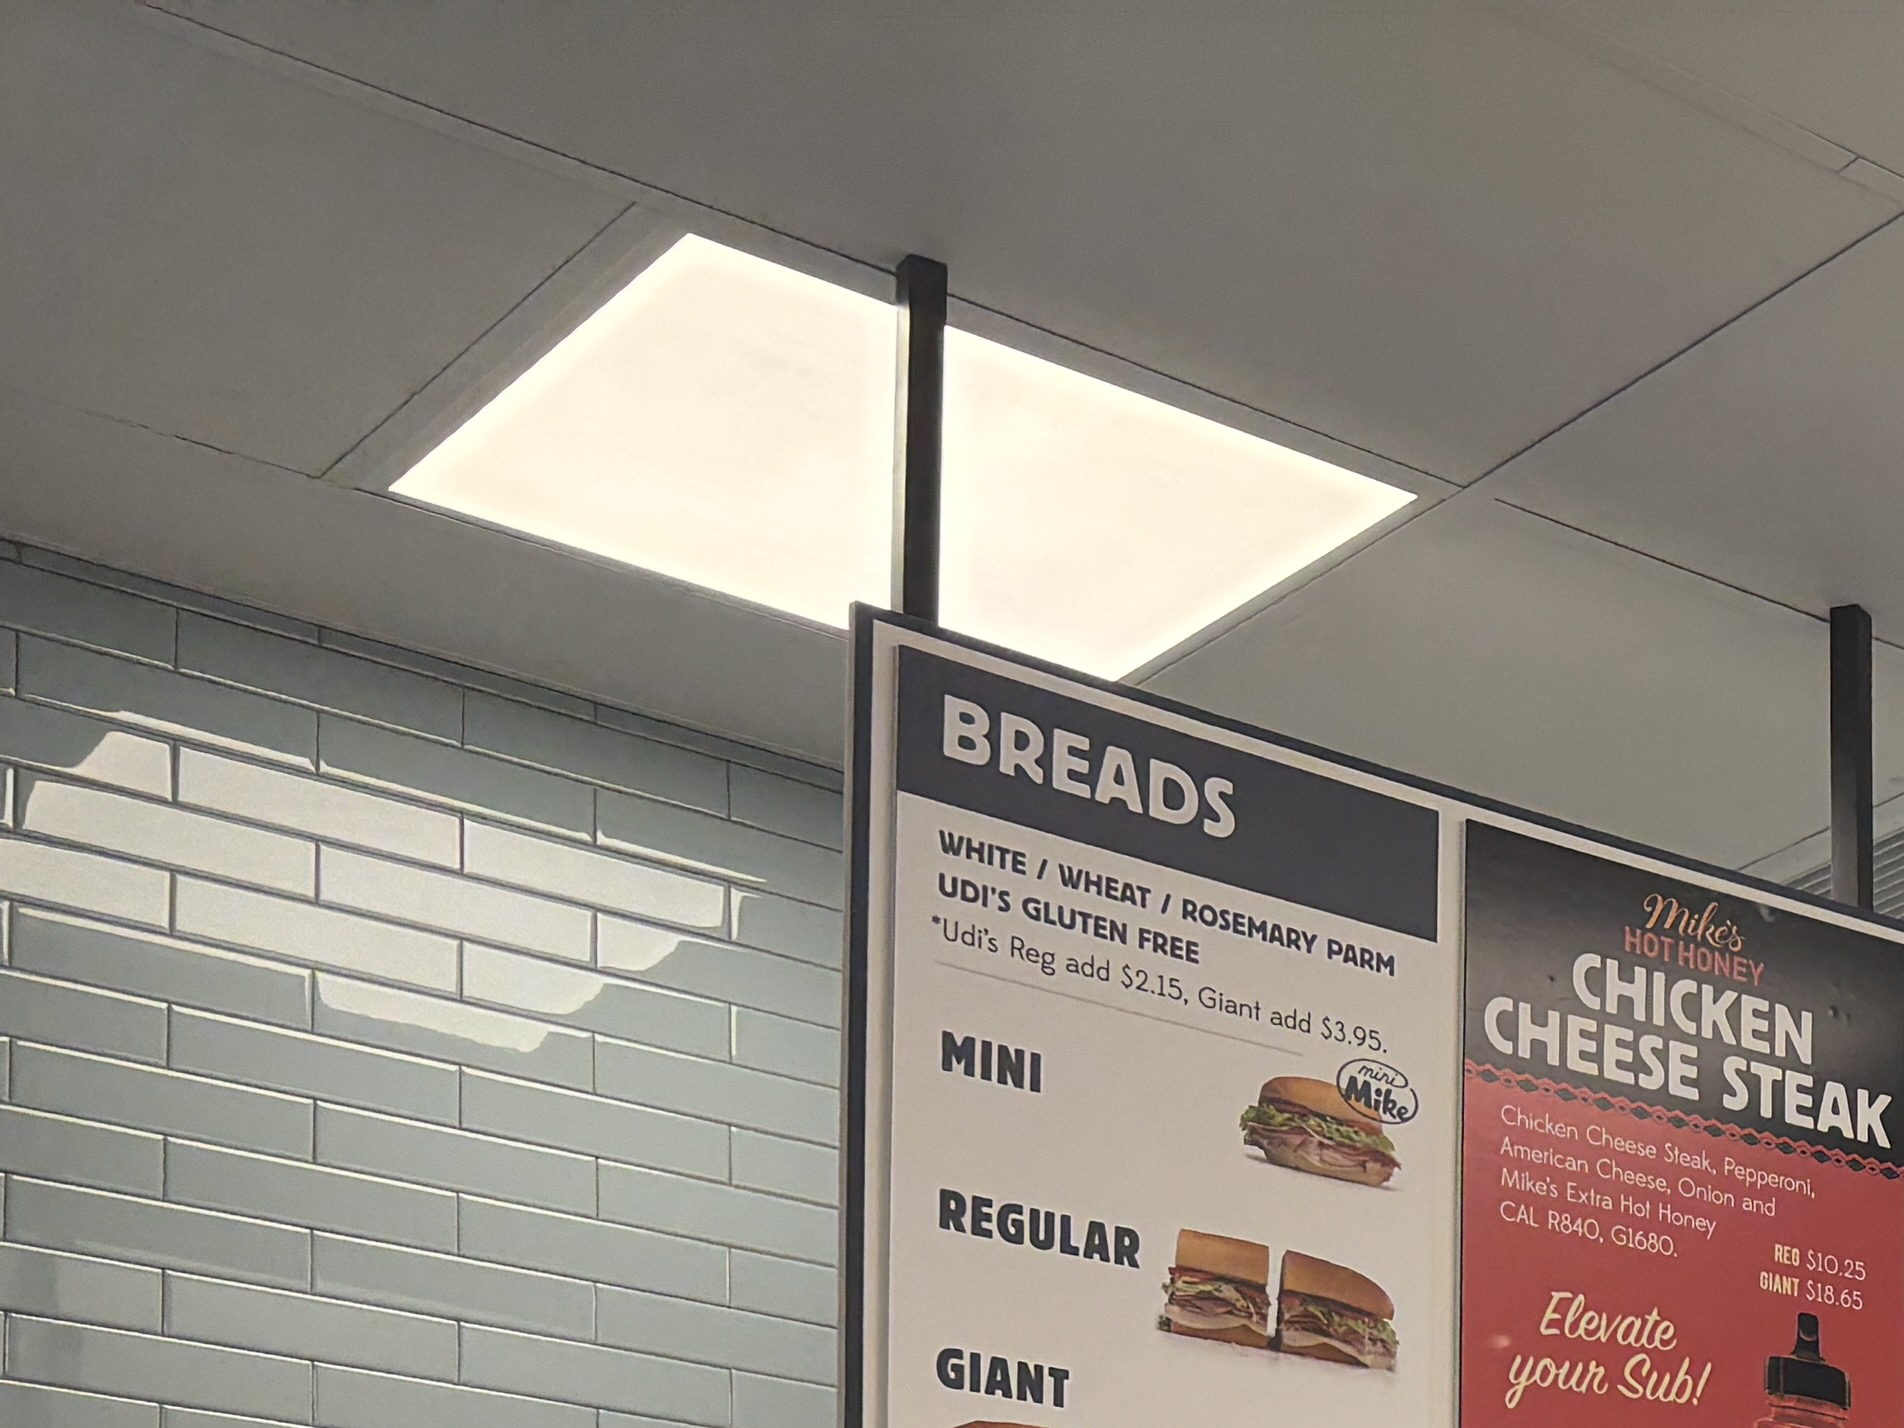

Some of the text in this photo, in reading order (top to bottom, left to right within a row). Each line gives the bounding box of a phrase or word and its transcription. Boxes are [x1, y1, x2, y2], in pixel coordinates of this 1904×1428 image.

[942, 694, 1236, 838] BREADS
[938, 829, 1027, 876] WHITE
[1058, 862, 1151, 909] WHEAT
[1182, 898, 1318, 954] ROSEMARY
[1327, 938, 1396, 977] PARM
[938, 872, 1200, 964] UDI'S GLUTEN FREE
[1643, 893, 1745, 952] Mike's
[1624, 926, 1765, 986] HOT HONEY
[1572, 953, 1813, 1065] CHICKEN
[941, 1030, 1042, 1093] MINI
[1484, 997, 1892, 1148] CHEESE STEAK
[1500, 1105, 1815, 1198] Chicken Cheese Steak, Pepperoni,
[938, 1188, 1141, 1268] REGULAR
[1759, 1271, 1863, 1310] GIANT $18.65
[1806, 1250, 1866, 1281] $10.25
[1539, 1291, 1677, 1351] Elevate
[936, 1348, 1070, 1408] GIANT
[1505, 1352, 1712, 1408] your Sub!
